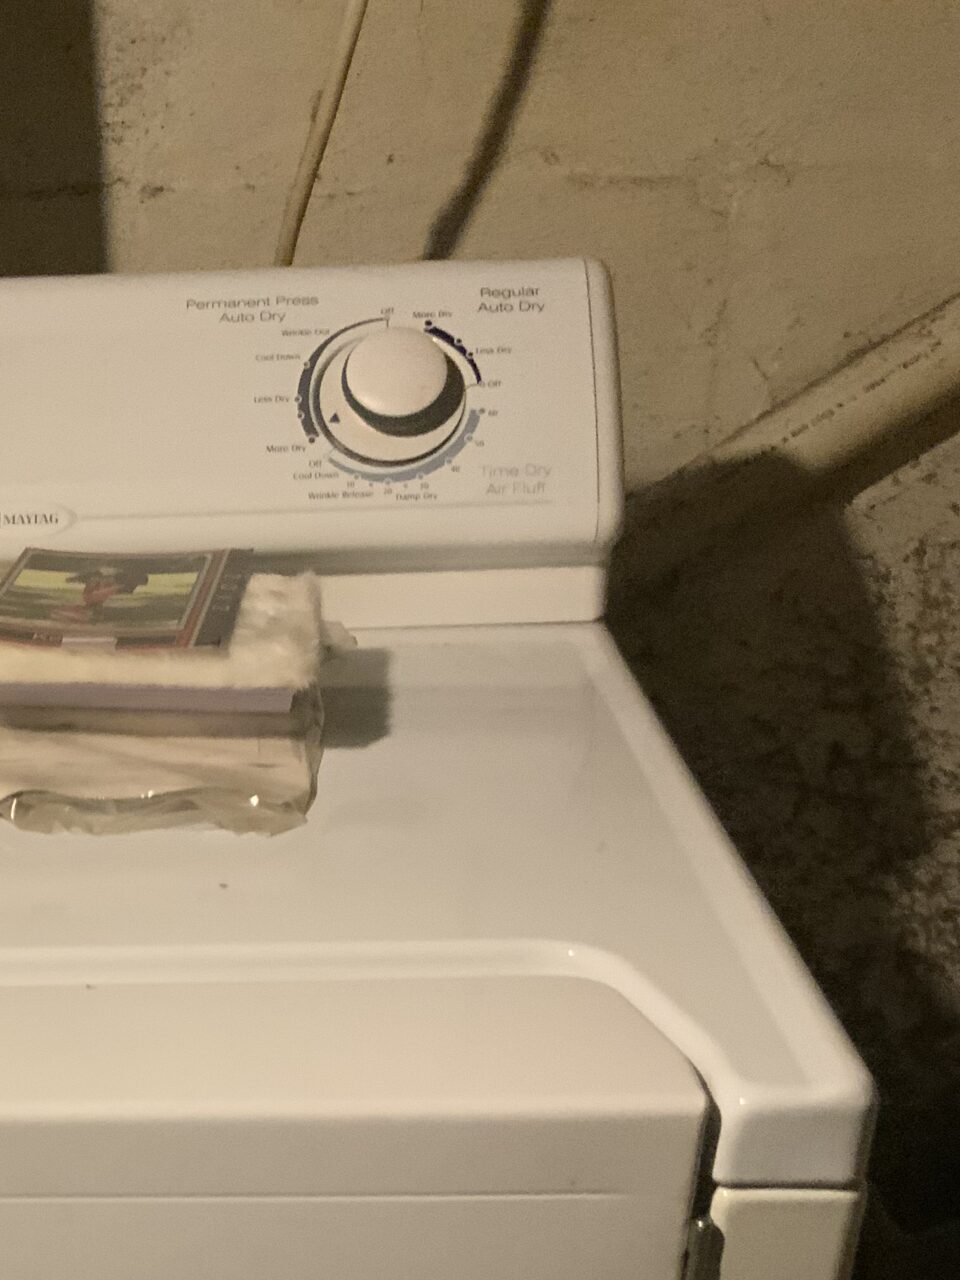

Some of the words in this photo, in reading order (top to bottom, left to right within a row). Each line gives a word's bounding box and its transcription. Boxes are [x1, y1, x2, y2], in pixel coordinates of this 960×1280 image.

[480, 287, 540, 299] Regular
[186, 297, 270, 310] Permanent
[276, 295, 319, 307] Press
[477, 302, 514, 313] Auto
[519, 301, 546, 313] Dry
[218, 312, 255, 323] Auto
[260, 311, 286, 323] Dry
[438, 310, 453, 319] Dry
[496, 347, 512, 355] Dry
[253, 396, 273, 404] Less
[274, 396, 290, 404] Dry
[266, 445, 288, 453] More
[291, 445, 306, 453] Dry
[482, 466, 519, 478] Time
[525, 464, 552, 478] Dry
[485, 484, 507, 495] Air
[513, 482, 546, 494] Fluff
[3, 513, 59, 525] MAYTAG
